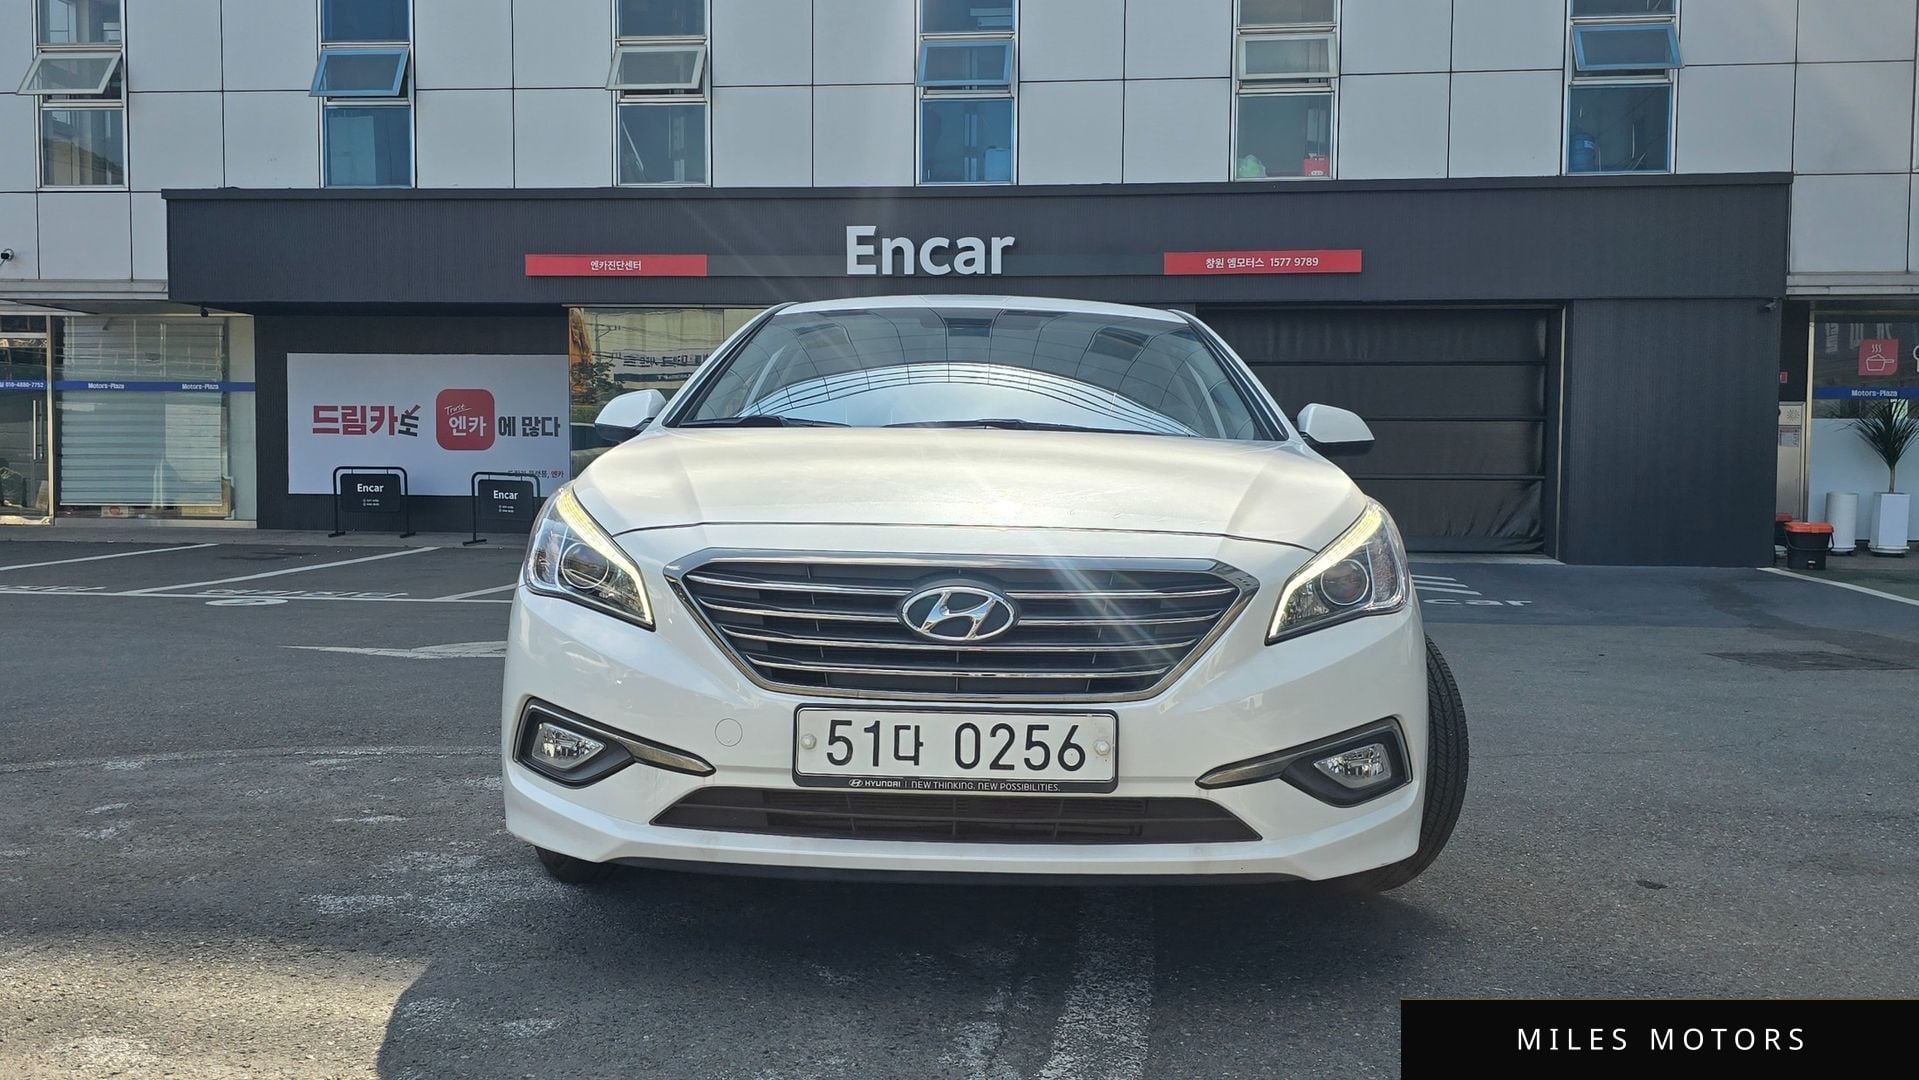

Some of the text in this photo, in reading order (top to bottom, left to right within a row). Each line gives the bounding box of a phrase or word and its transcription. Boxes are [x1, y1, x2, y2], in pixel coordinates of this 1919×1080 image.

[846, 226, 1016, 276] Encar
[590, 260, 642, 271] 엔카진단센터
[1205, 257, 1319, 269] 창원 엠모터스 1577 9789
[1851, 389, 1898, 397] Motors-Plaza
[449, 416, 487, 437] 엔카
[498, 416, 516, 437] 에
[521, 416, 560, 437] 많다
[357, 483, 384, 493] Encar
[493, 490, 518, 500] Encar
[826, 719, 1086, 772] 51다 0256
[865, 780, 1061, 792] HYUNDAI NEW THINKING. NEW POSSIBILITIES.
